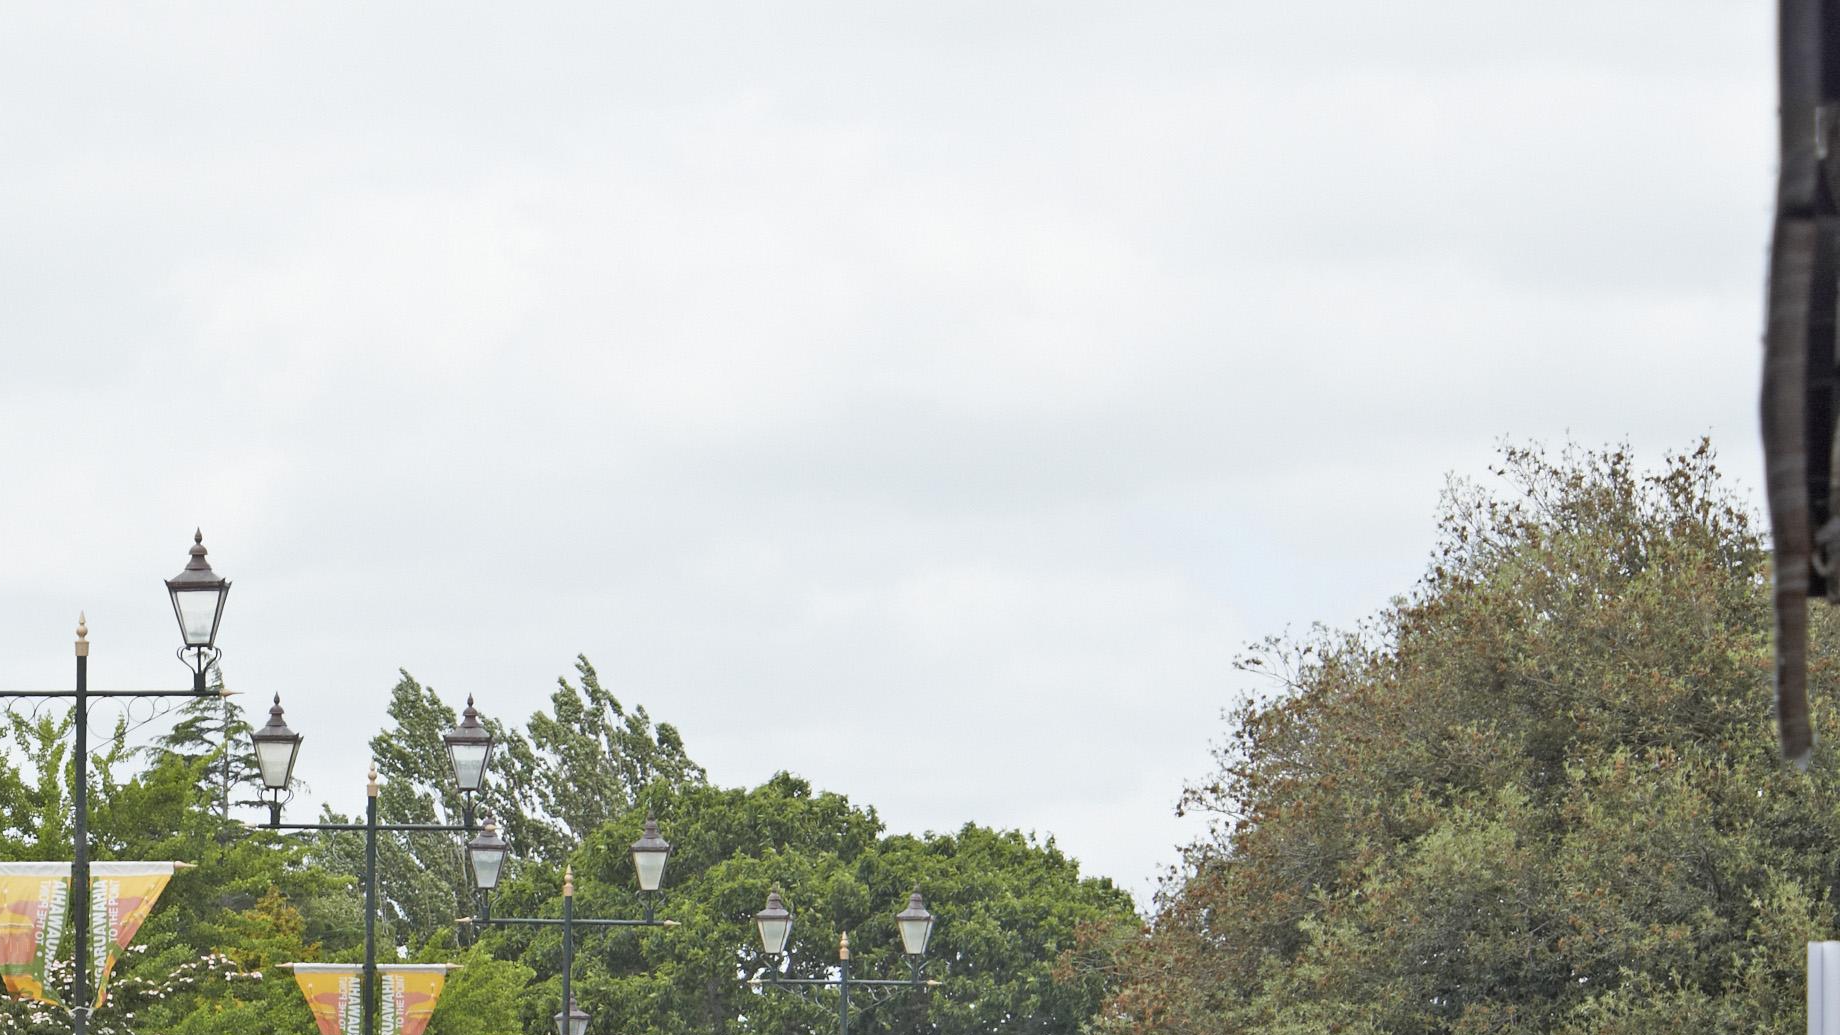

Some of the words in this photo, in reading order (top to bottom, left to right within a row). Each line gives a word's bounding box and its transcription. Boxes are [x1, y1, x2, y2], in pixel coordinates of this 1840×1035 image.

[109, 880, 120, 905] POINT
[109, 908, 118, 926] THE
[109, 929, 117, 943] TO
[396, 975, 404, 998] POINT
[396, 999, 404, 1015] THE
[396, 1017, 403, 1029] TO
